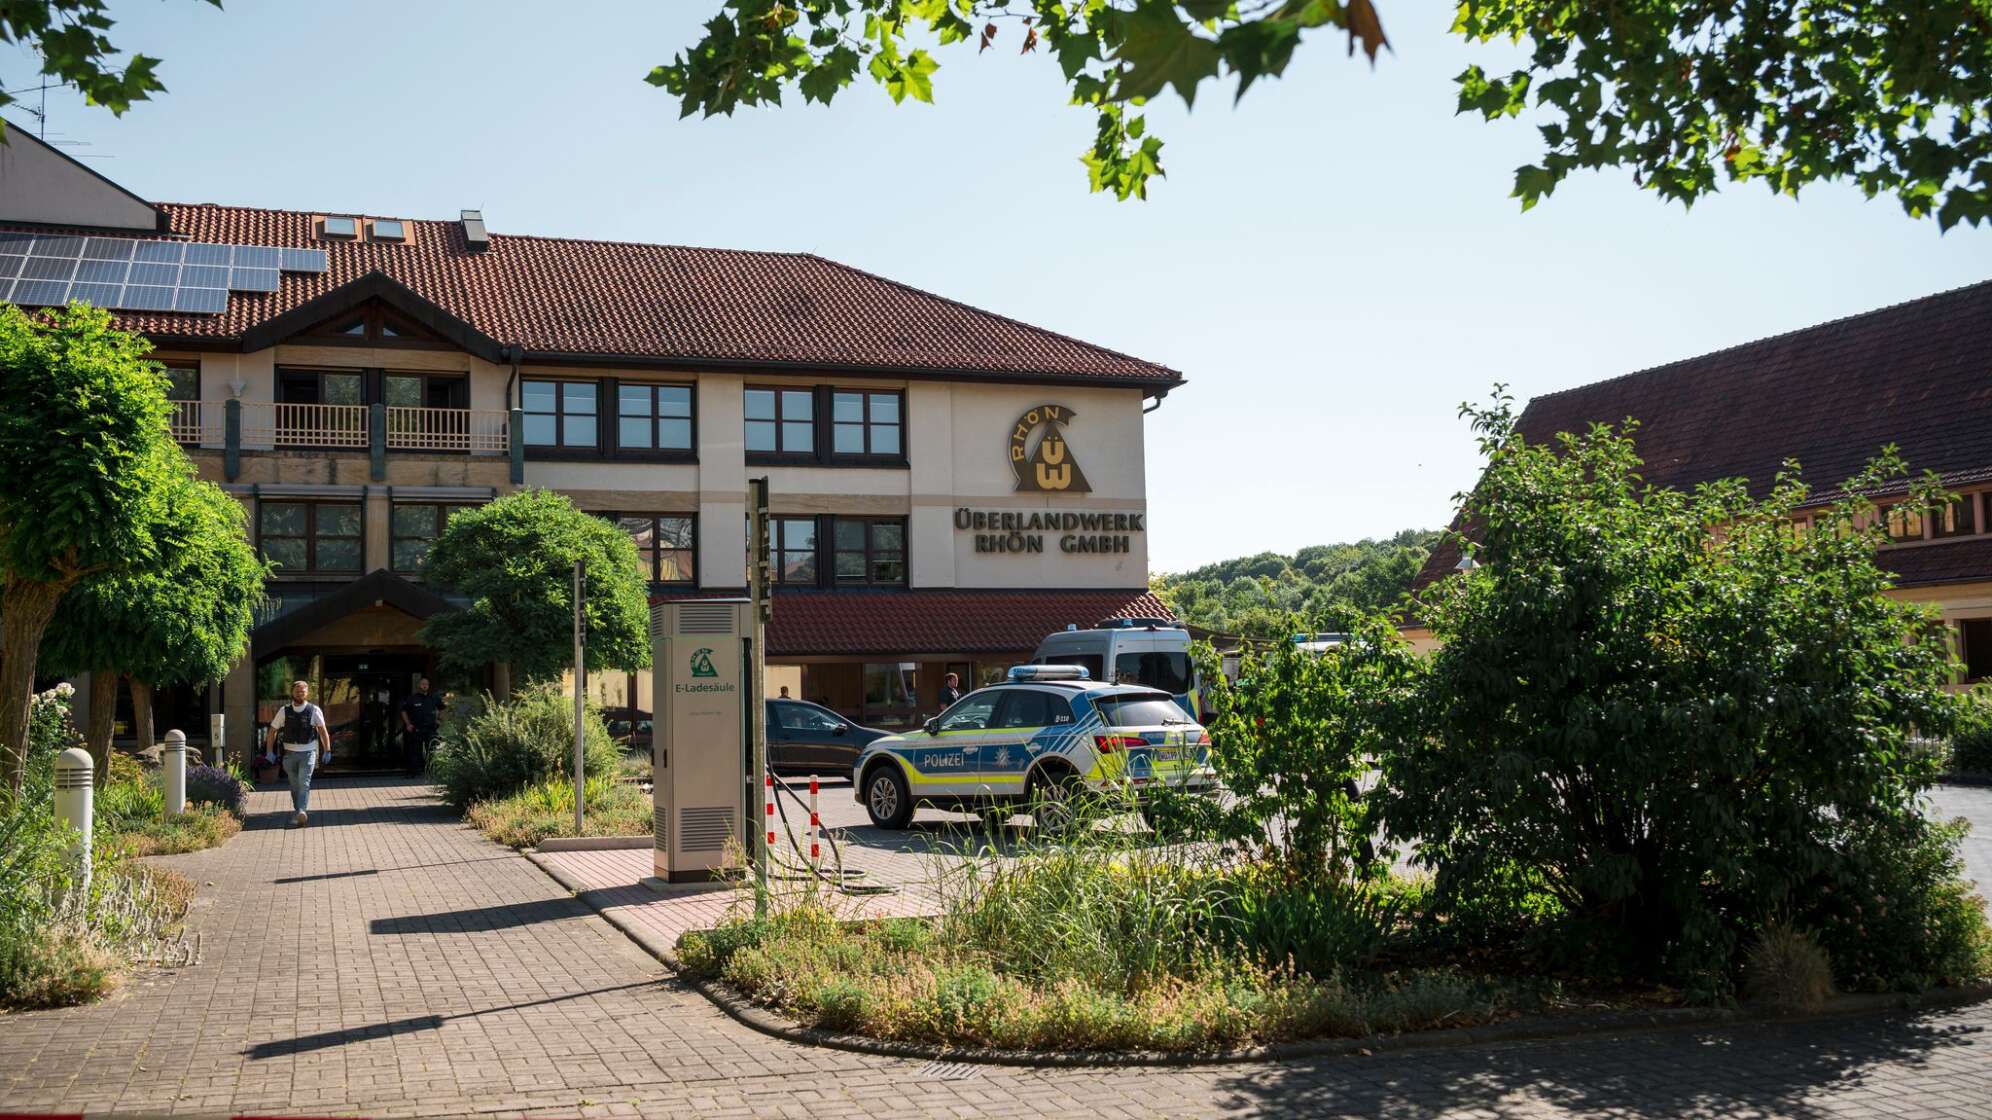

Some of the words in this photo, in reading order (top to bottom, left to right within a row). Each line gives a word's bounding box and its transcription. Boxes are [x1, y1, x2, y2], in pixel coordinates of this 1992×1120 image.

[1012, 406, 1060, 461] RHÖN
[954, 508, 1144, 531] ÜBERLANDWERK
[975, 532, 1043, 553] RHÖN
[1059, 535, 1130, 553] GMBH
[675, 682, 736, 693] E-Ladesäule
[924, 752, 965, 768] POLIZEI
